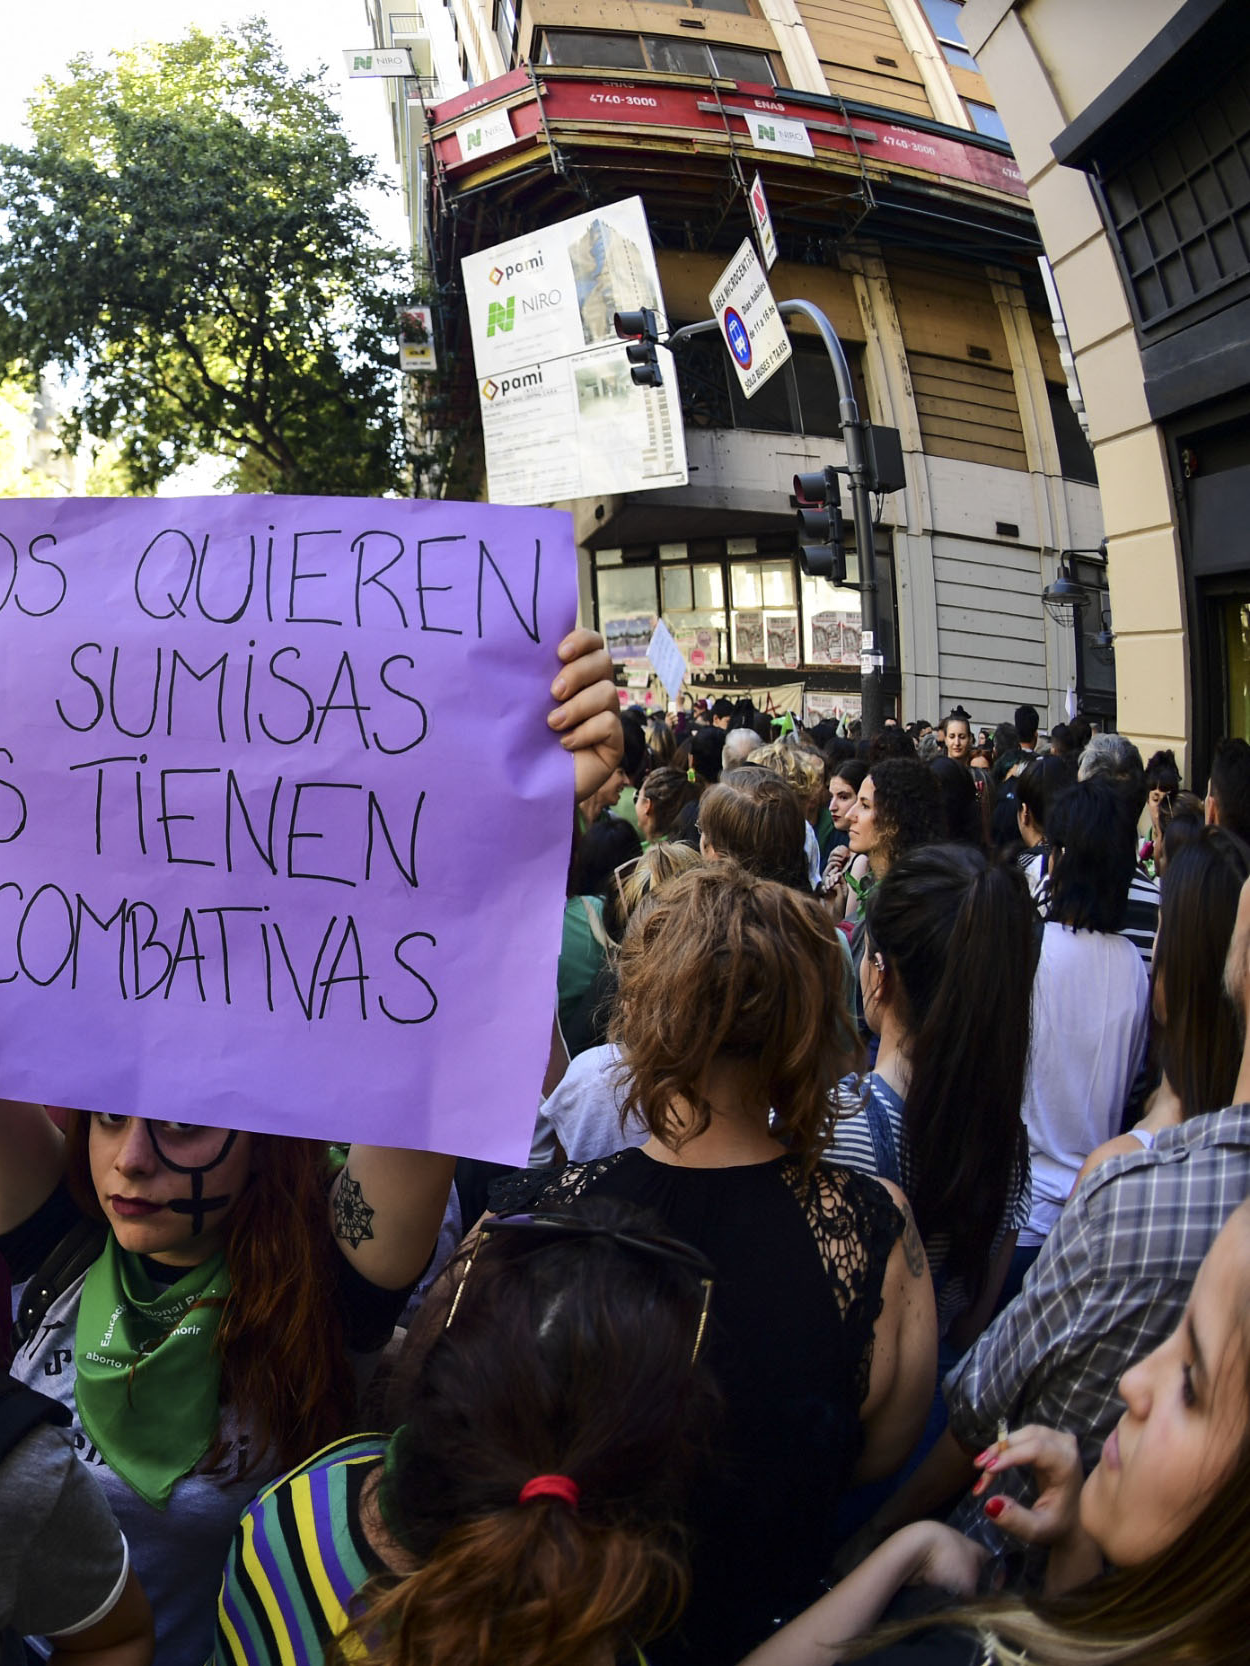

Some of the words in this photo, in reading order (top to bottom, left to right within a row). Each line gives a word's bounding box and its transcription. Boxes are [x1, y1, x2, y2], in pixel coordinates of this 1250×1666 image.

[376, 56, 403, 65] NIRO
[589, 94, 657, 107] 4740-3000
[754, 99, 786, 111] ENAS
[778, 129, 804, 141] NIRO
[883, 135, 936, 155] 4740-3000
[505, 250, 544, 280] pami
[521, 289, 562, 315] NIRO
[772, 339, 788, 361] TAXIS
[501, 363, 543, 396] pami
[85, 1351, 122, 1369] aborto
